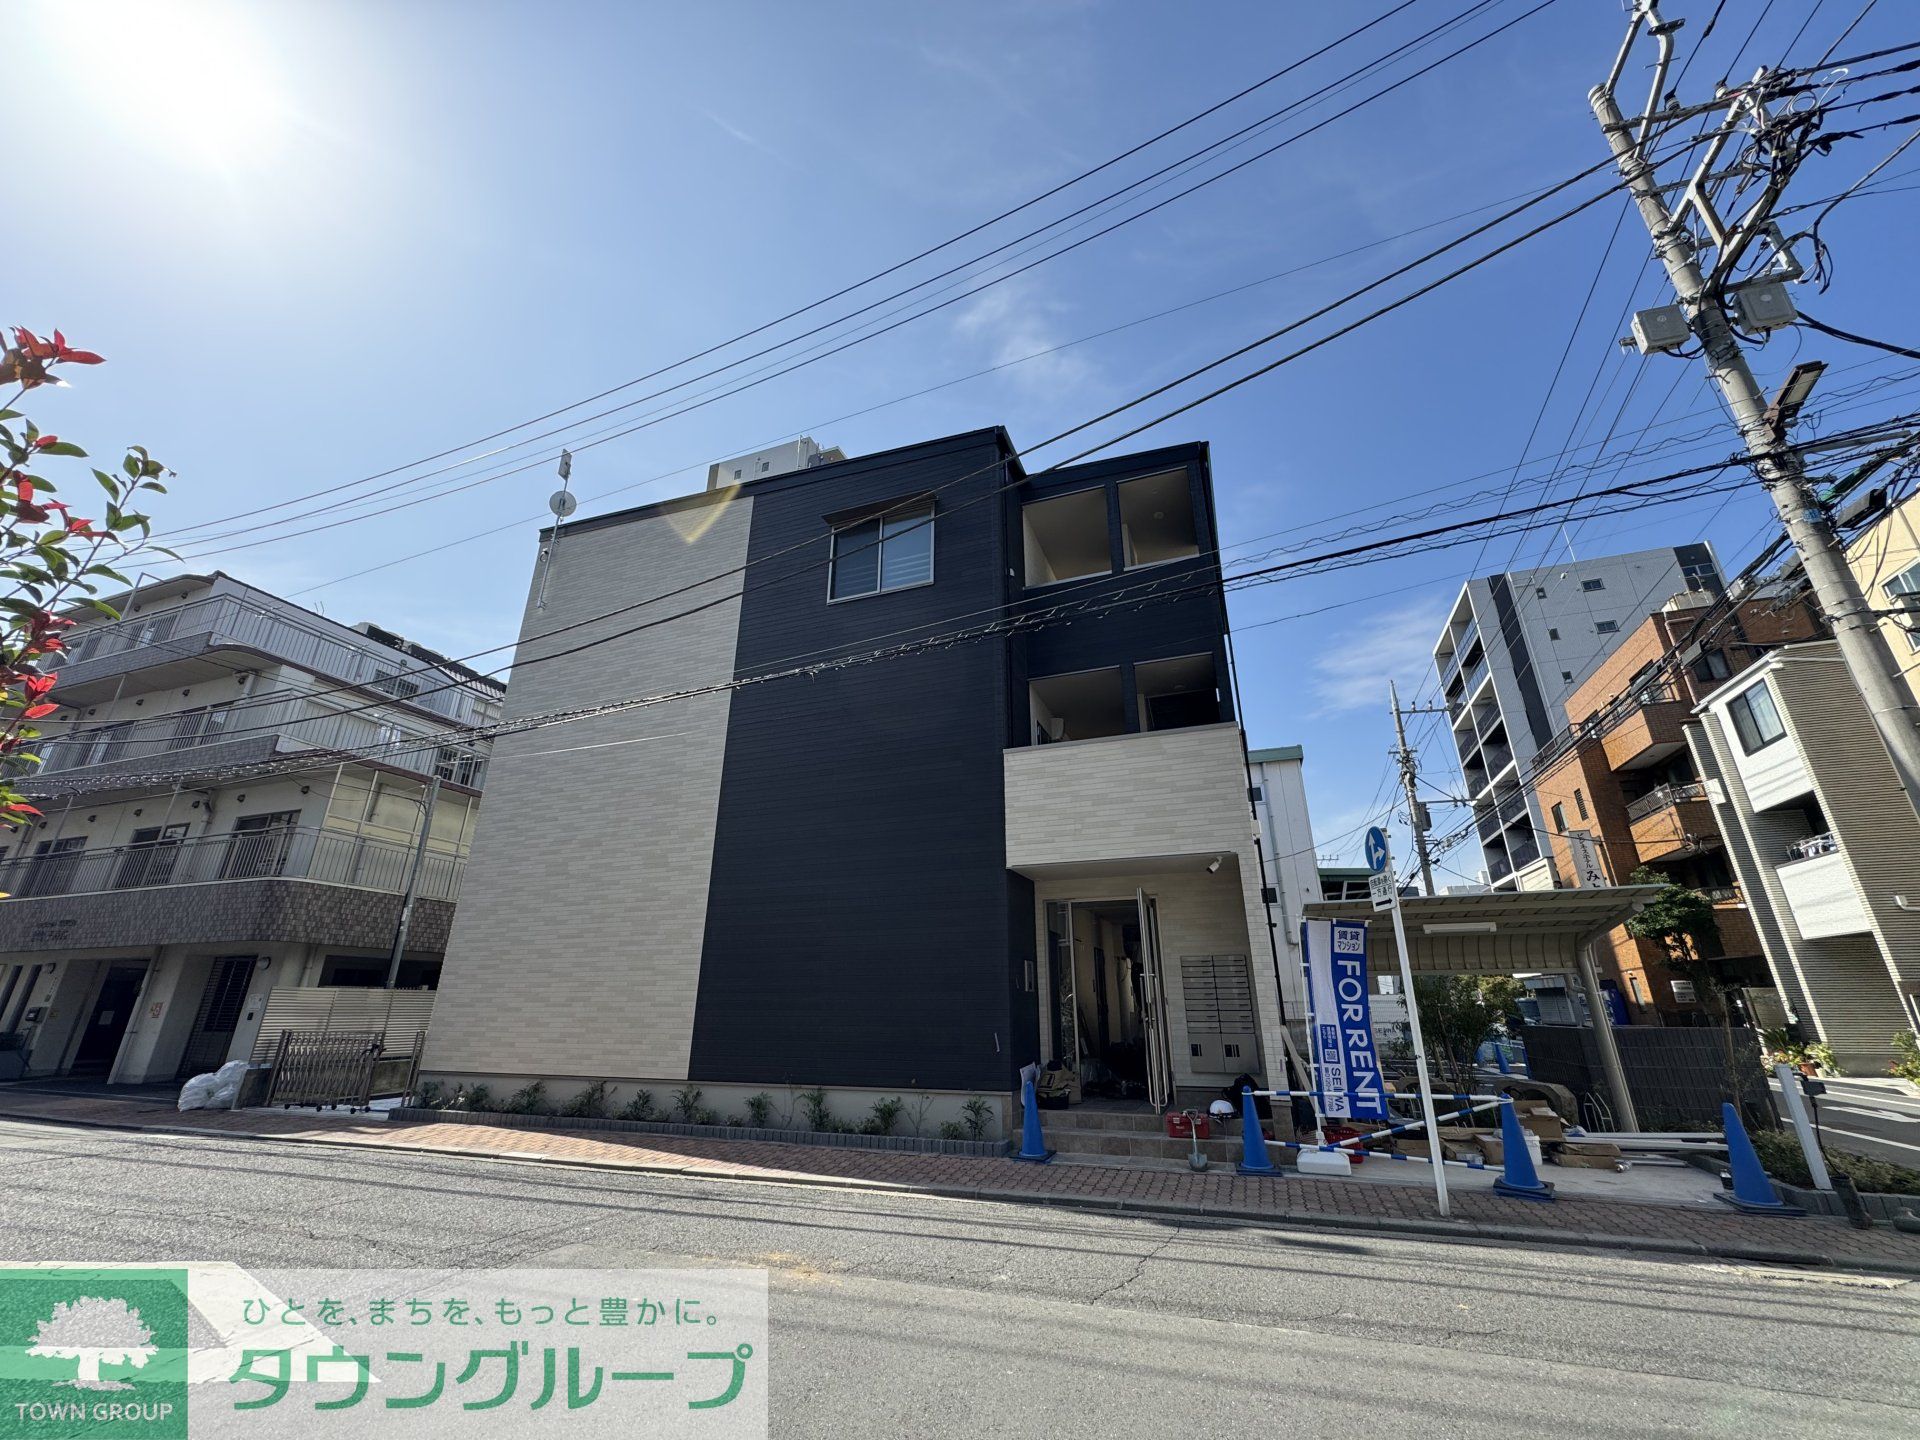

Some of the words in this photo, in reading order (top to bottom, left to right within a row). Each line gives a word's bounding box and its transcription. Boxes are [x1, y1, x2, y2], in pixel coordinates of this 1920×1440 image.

[1577, 832, 1593, 869] ビジネスホテル
[1372, 885, 1393, 898] 一方通行
[1338, 930, 1360, 941] 賃貸
[1338, 940, 1360, 952] マンション
[1337, 960, 1364, 1022] FOR
[1345, 1029, 1382, 1115] RENT
